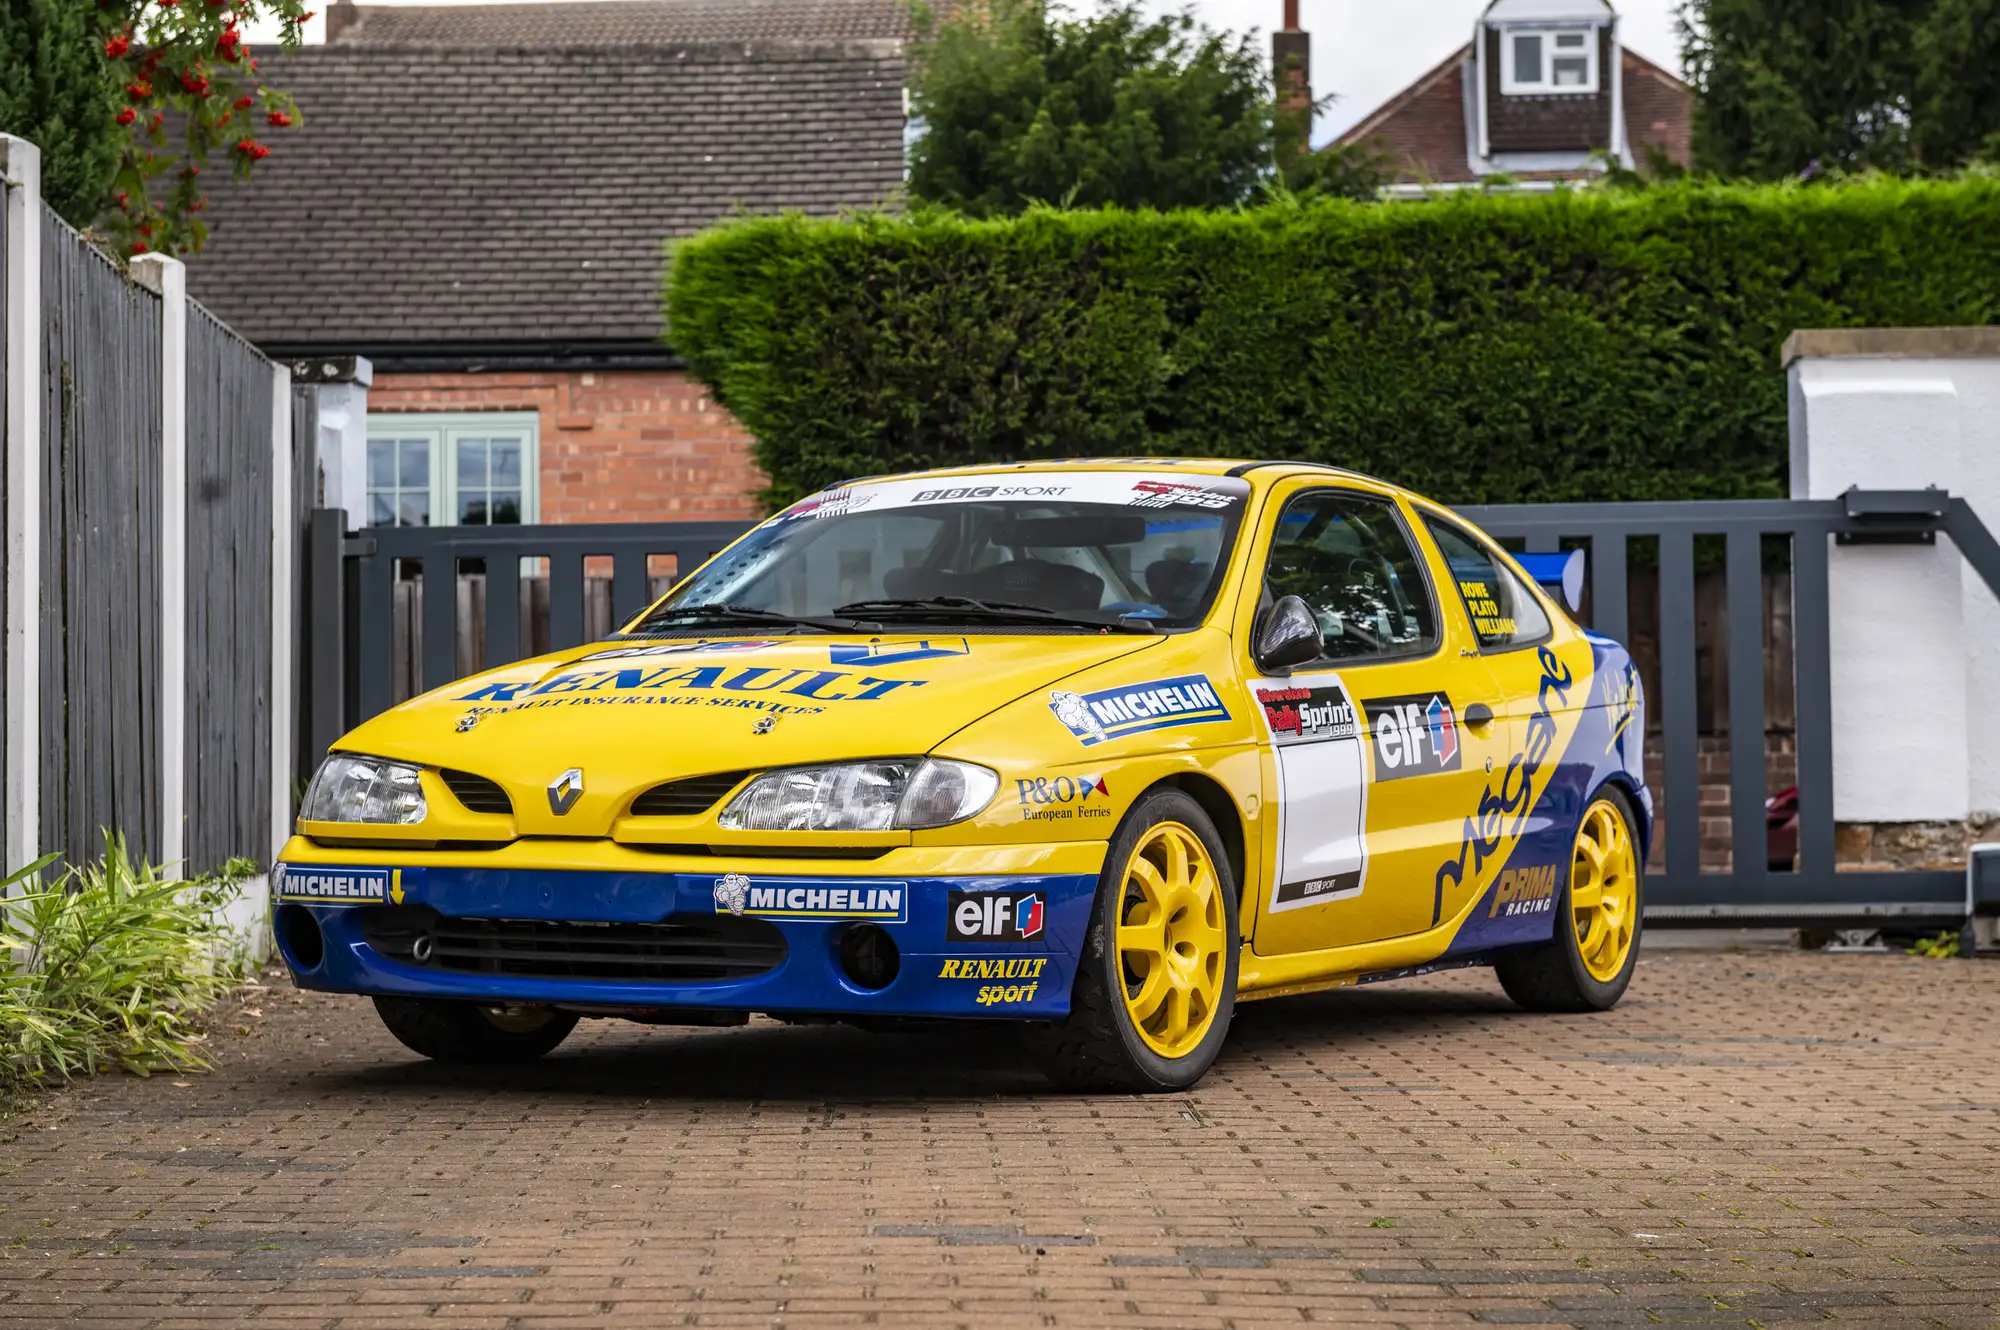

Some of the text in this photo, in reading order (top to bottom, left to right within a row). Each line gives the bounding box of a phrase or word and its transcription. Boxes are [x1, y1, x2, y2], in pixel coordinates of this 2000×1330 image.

[911, 486, 1072, 502] BBC SPORT
[1460, 581, 1489, 598] ROWE
[1468, 599, 1498, 617] PLATO
[1474, 617, 1518, 635] WILLIAMS
[451, 666, 930, 702] RENAULT
[464, 696, 828, 715] RENAULT INSURANCE SERVICES
[1090, 684, 1218, 724] MICHELIN
[1329, 723, 1353, 738] 1999
[1376, 702, 1426, 769] elf
[1015, 776, 1075, 805] P&O
[1023, 805, 1111, 822] European Ferries
[285, 875, 384, 896] MICHELIN
[1487, 864, 1557, 919] PRIMA
[750, 887, 901, 911] MICHELIN
[1505, 898, 1552, 917] RACING
[955, 896, 1011, 936] elf
[938, 958, 1048, 980] RENAULT
[976, 981, 1038, 1007] sport
